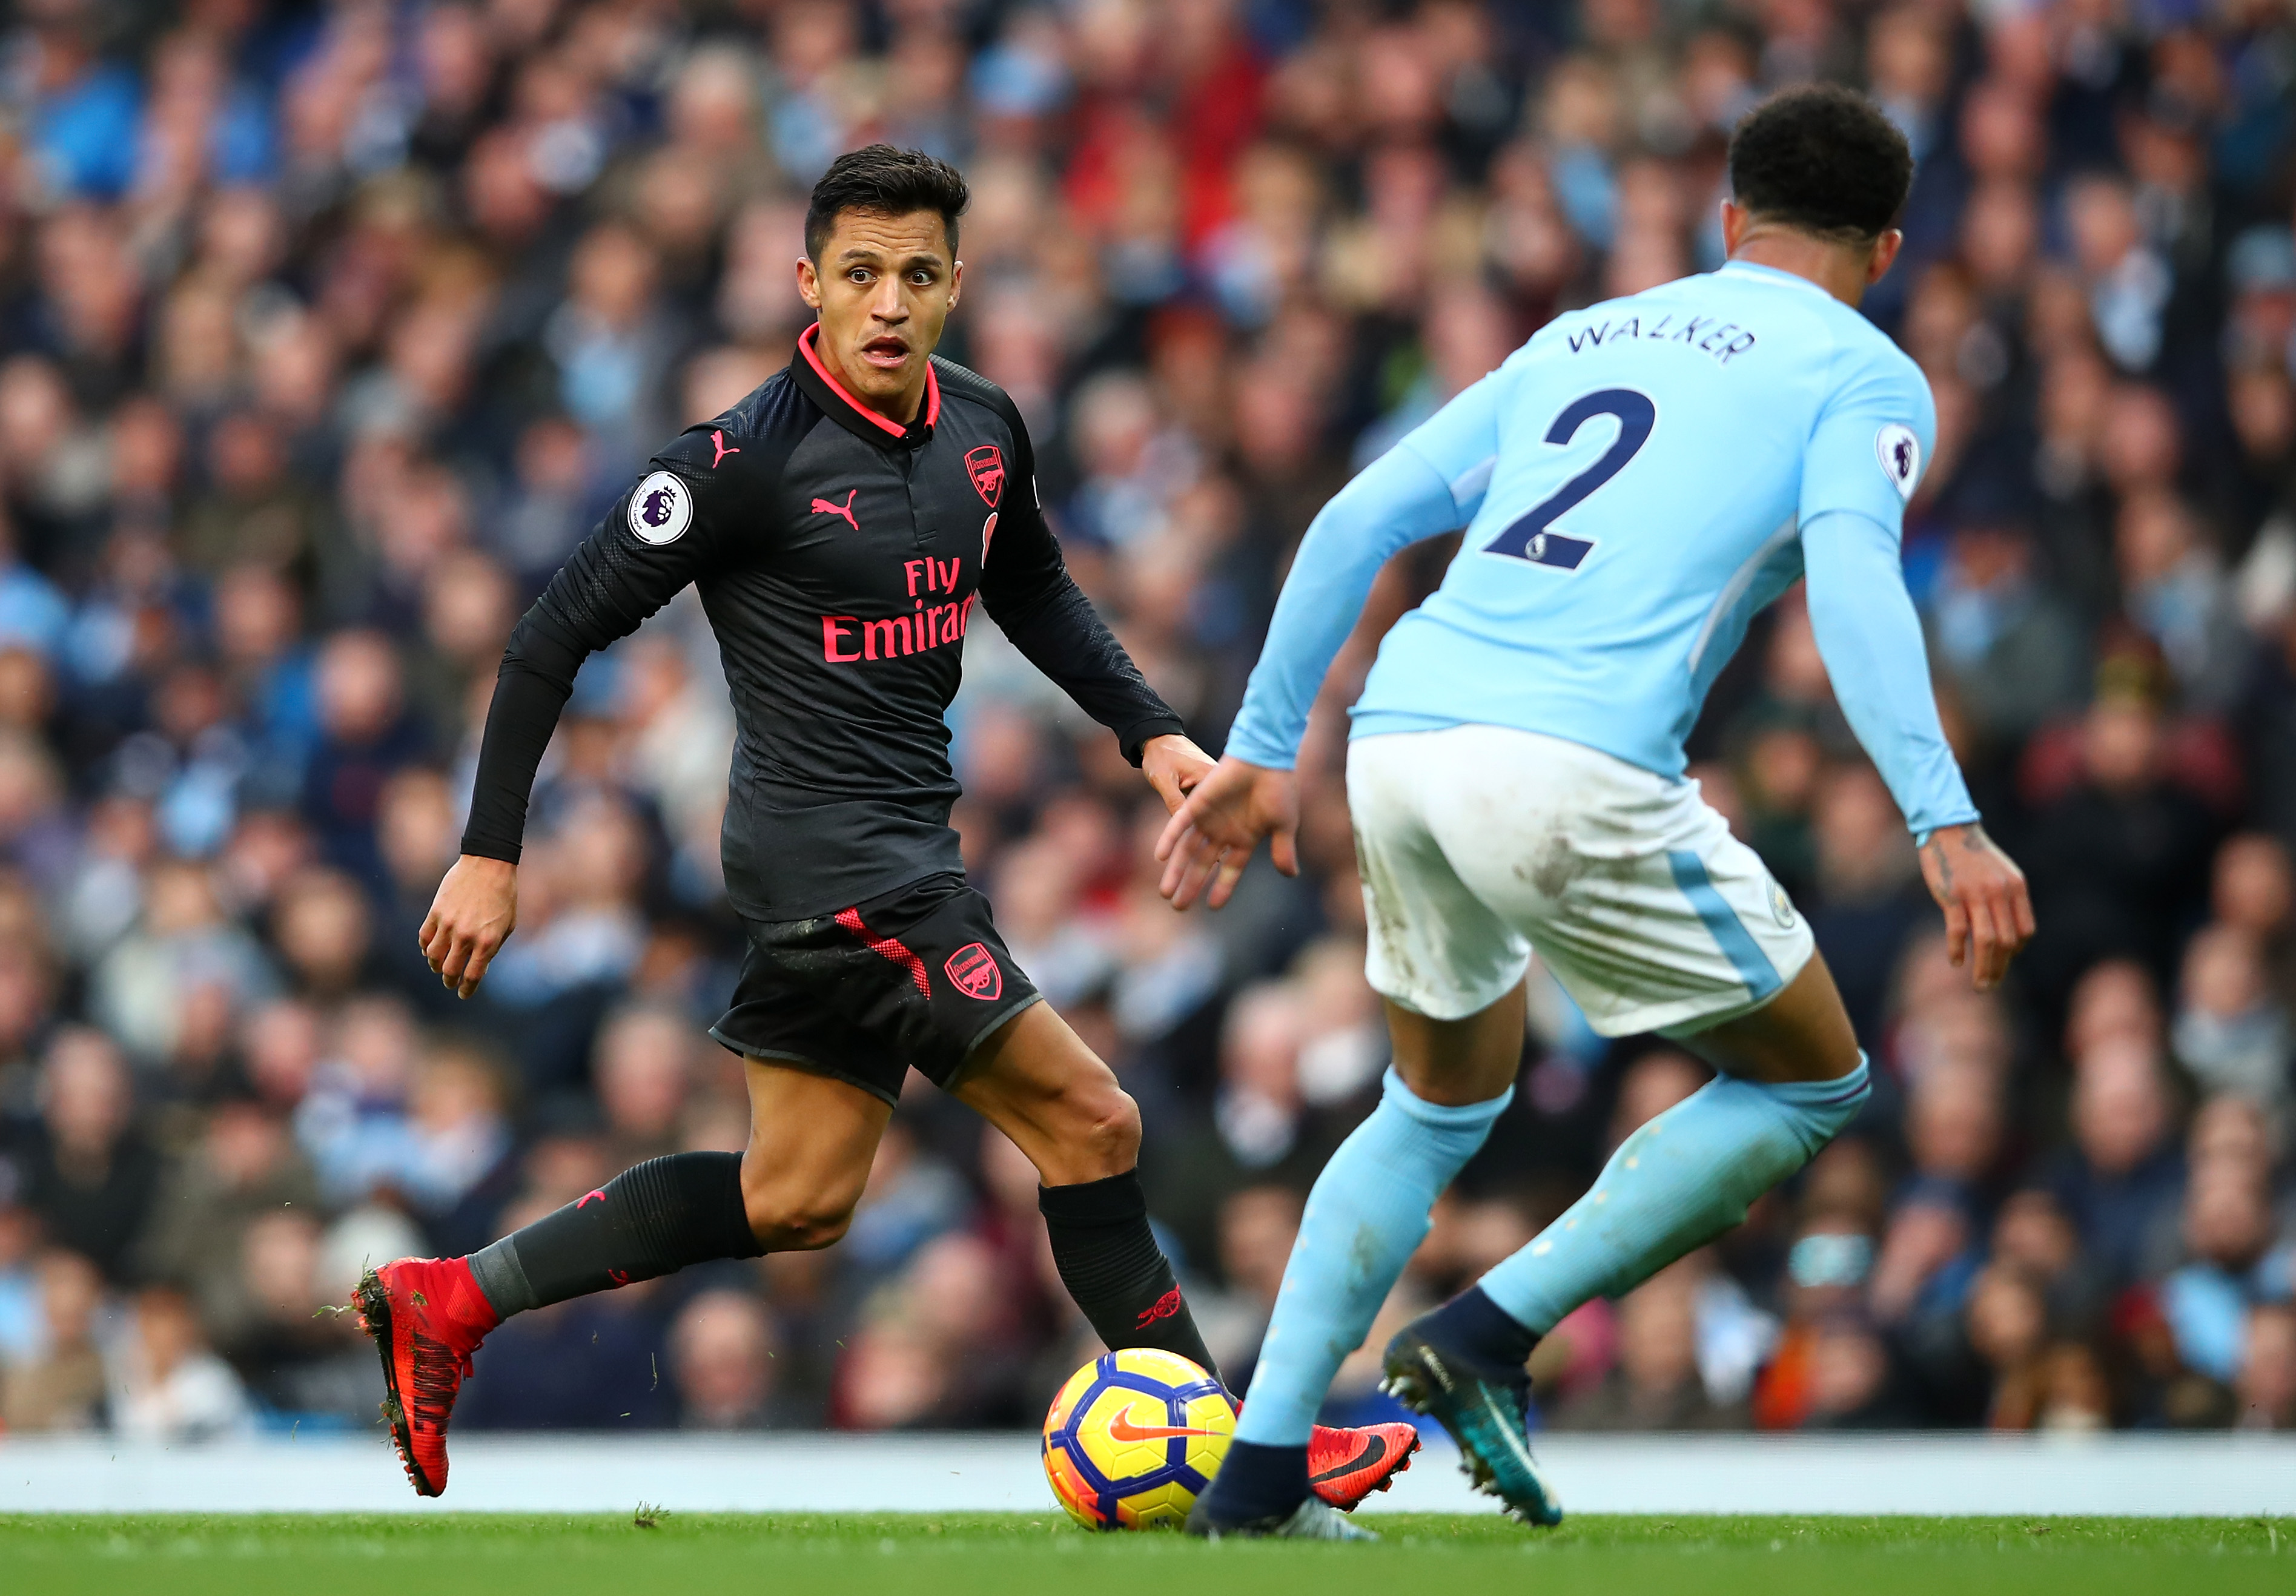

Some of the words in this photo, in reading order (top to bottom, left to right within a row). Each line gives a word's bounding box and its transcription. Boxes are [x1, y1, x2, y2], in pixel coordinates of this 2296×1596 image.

[1567, 314, 1755, 364] WALKER
[1482, 389, 1655, 570] 2
[904, 556, 961, 597] Fly
